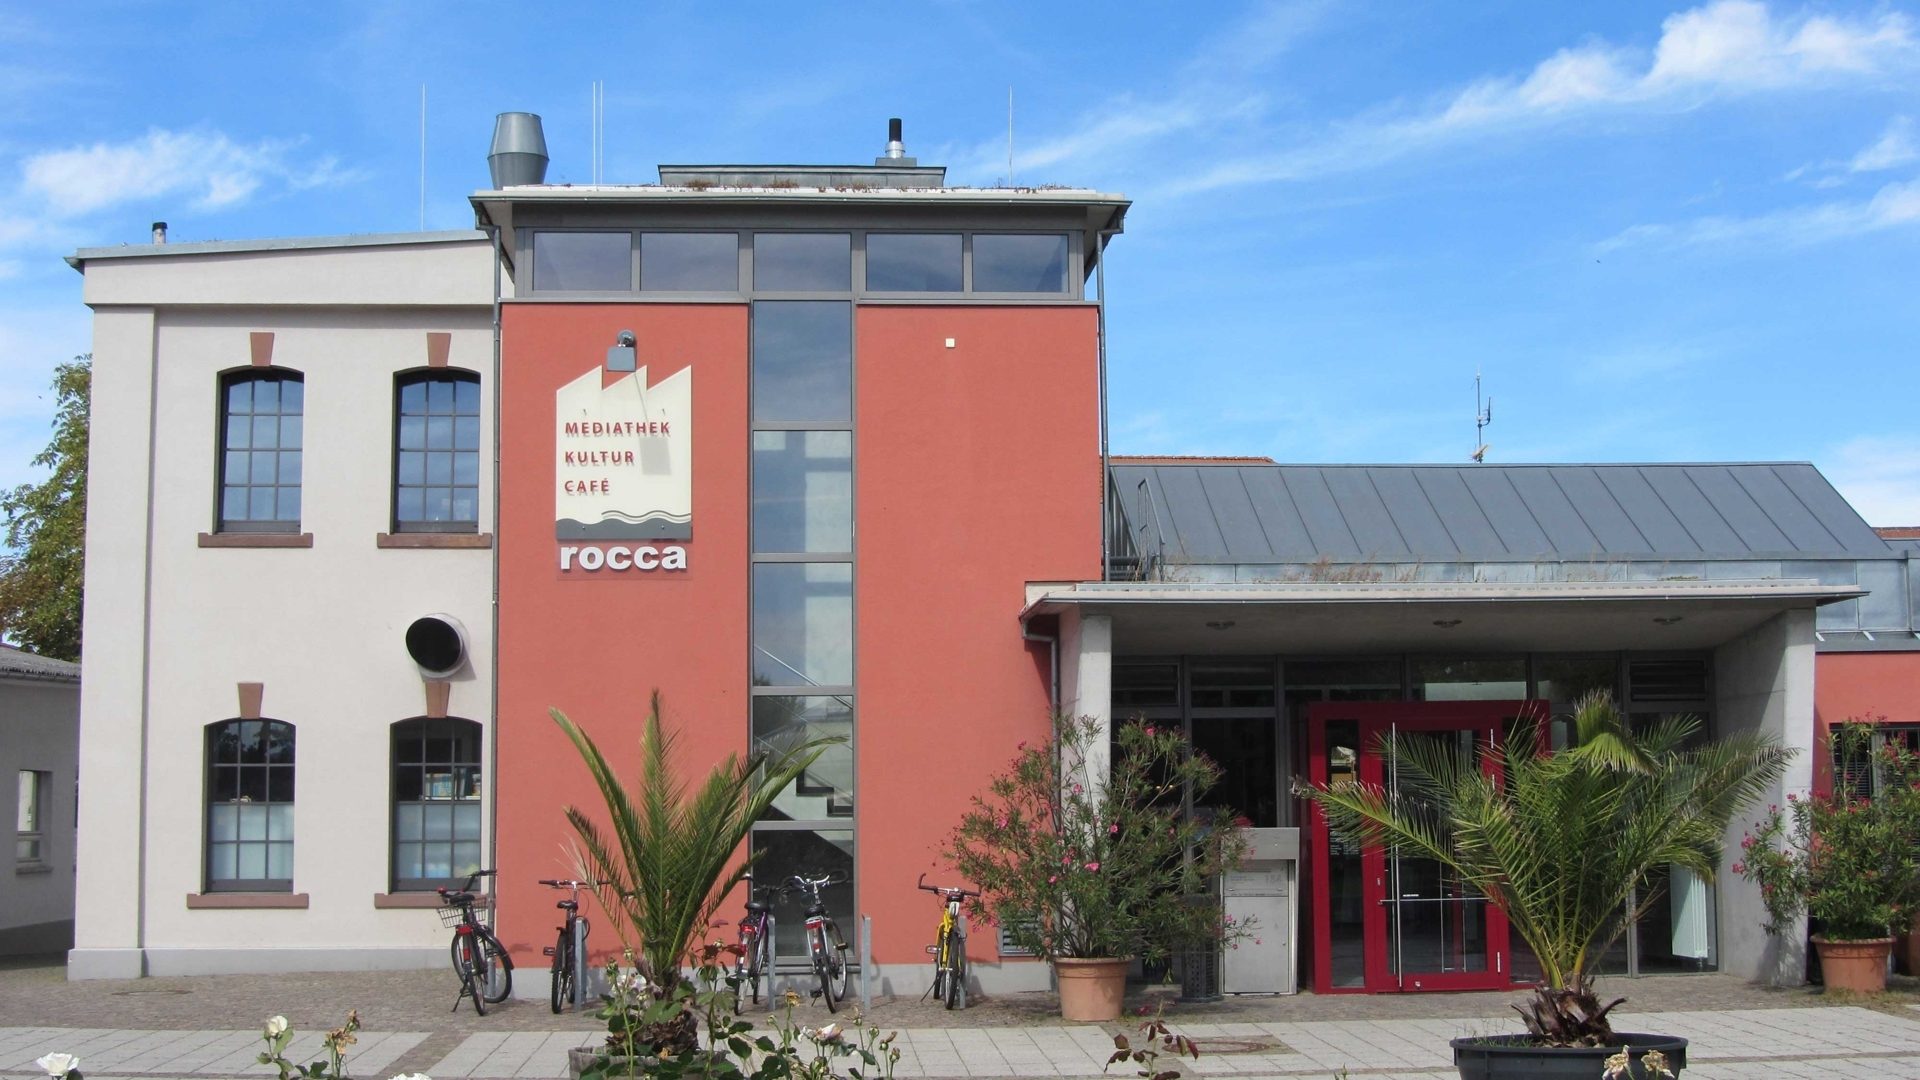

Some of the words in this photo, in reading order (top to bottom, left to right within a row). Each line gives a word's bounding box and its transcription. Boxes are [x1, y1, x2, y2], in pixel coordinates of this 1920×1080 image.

[565, 422, 669, 434] MEDIATHEK
[565, 451, 634, 463] KULTUR
[564, 478, 609, 492] CAFÉ
[560, 546, 687, 570] rocca
